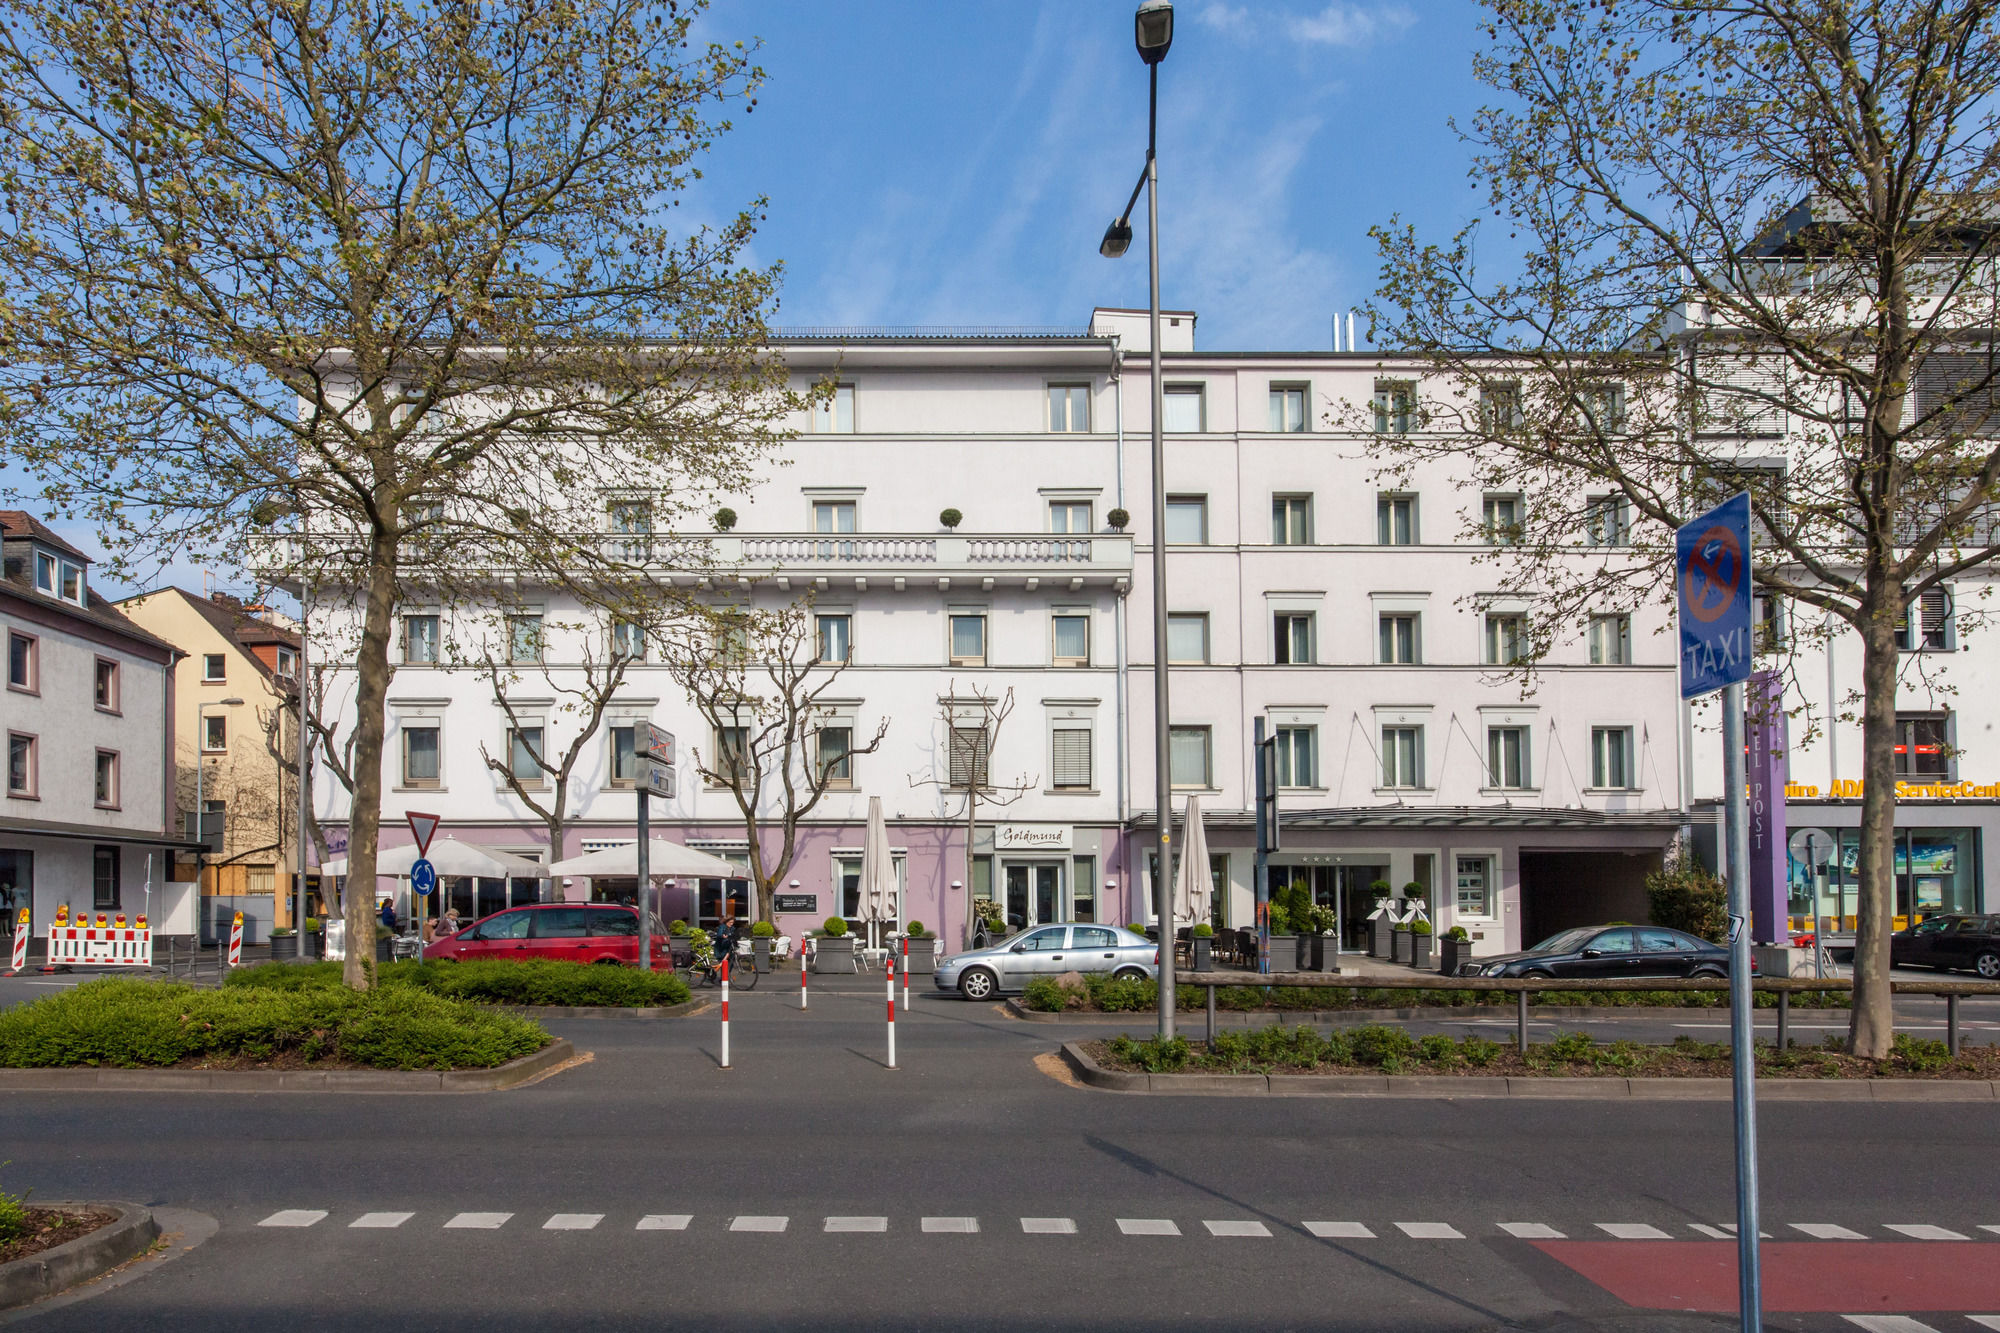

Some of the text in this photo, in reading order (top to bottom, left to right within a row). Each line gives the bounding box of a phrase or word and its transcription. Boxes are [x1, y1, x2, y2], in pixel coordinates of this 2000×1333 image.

[1687, 626, 1743, 679] TAXI
[1003, 827, 1063, 846] Goldmund
[1754, 783, 1764, 849] POST
